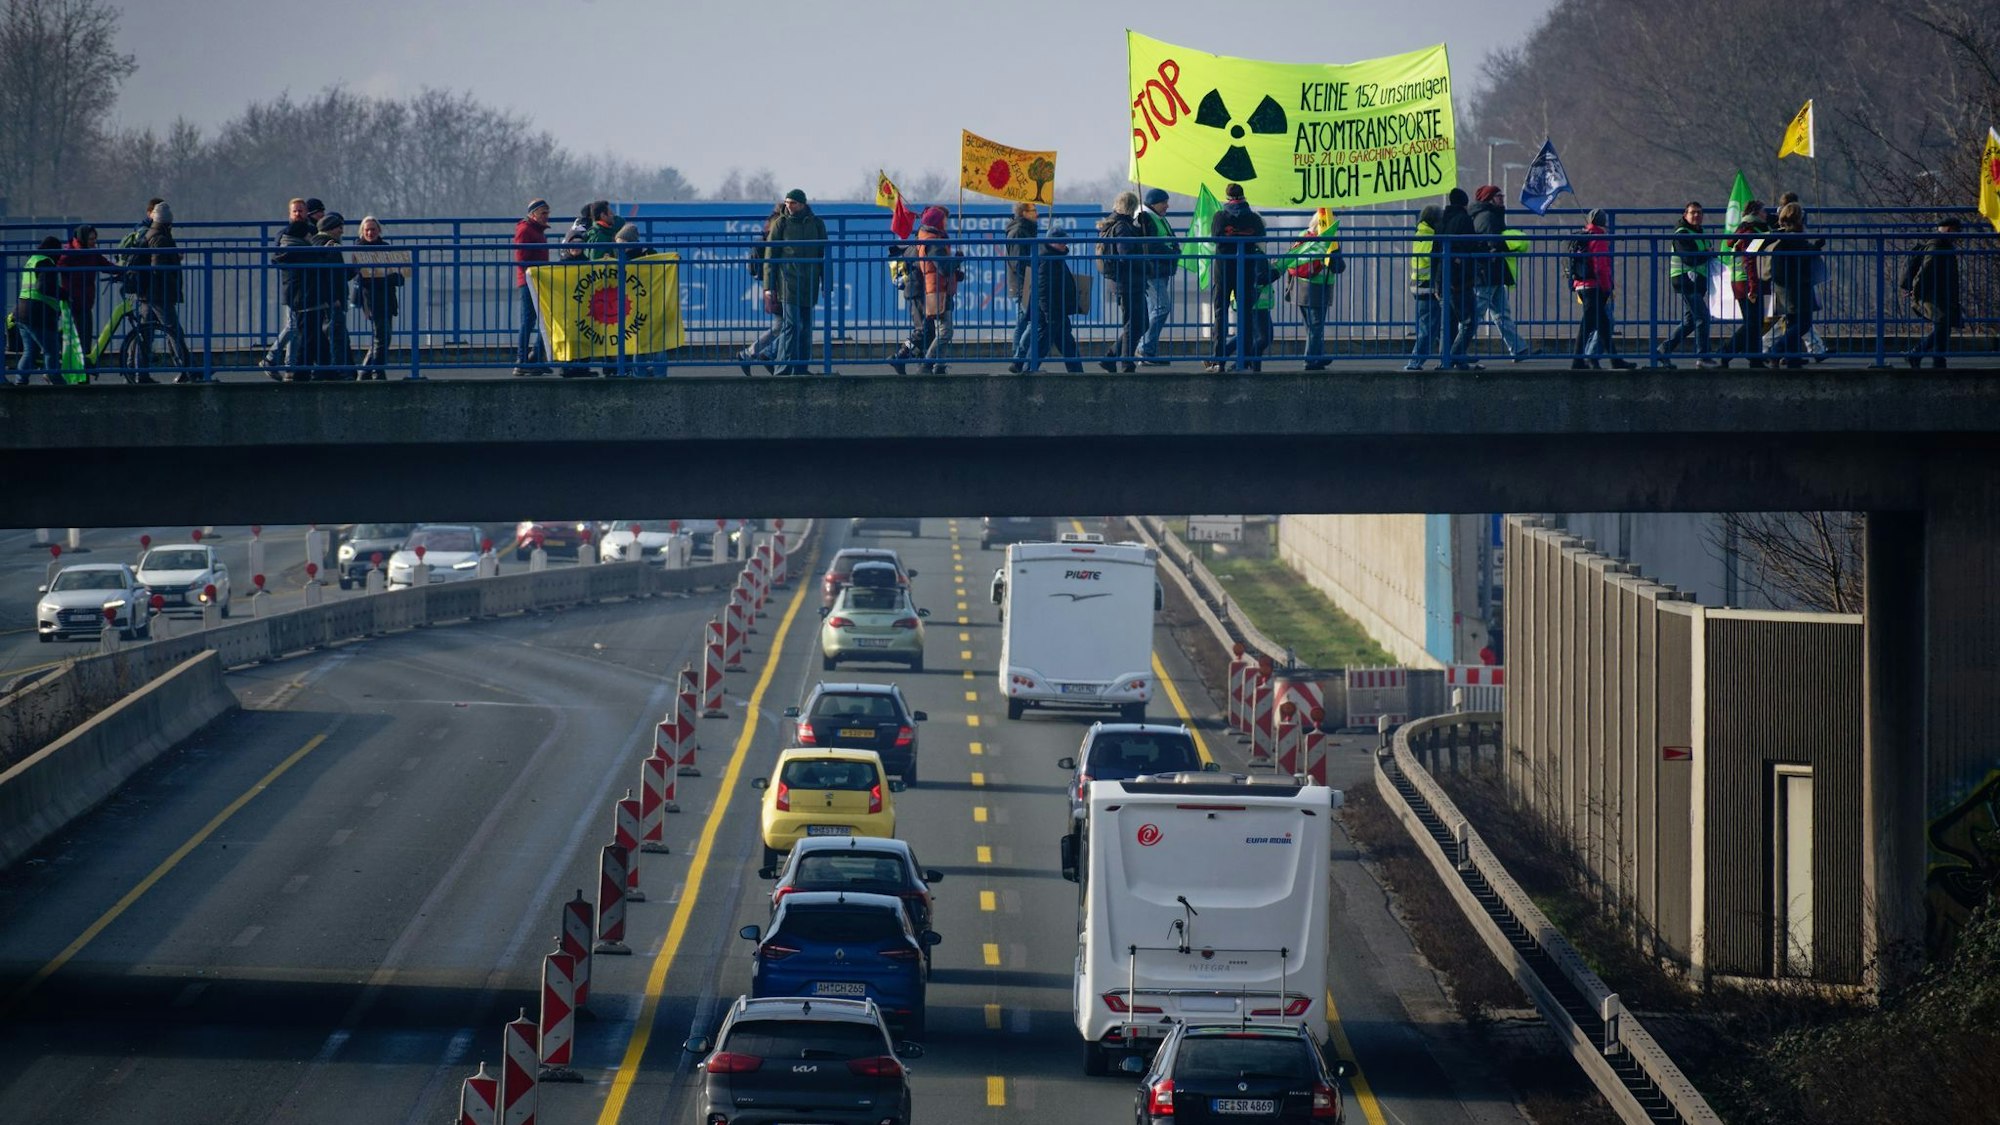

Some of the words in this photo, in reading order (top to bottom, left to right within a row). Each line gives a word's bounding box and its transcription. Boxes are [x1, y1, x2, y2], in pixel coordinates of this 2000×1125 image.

[1300, 82, 1350, 112] KEINE
[1355, 83, 1379, 108] 152
[1380, 76, 1448, 105] unsinnigen
[1132, 59, 1191, 158] STOP
[1294, 108, 1443, 153] ATOMTRANSPORTE
[1294, 153, 1315, 166] PLUS
[573, 268, 647, 303] ATOMKRFT?
[577, 318, 605, 346] NEIN
[610, 311, 648, 347] DNKE
[1064, 570, 1102, 580] PILOTE
[1188, 963, 1230, 972] INTEGRA
[818, 984, 829, 992] AH
[834, 984, 846, 993] CH
[792, 1065, 818, 1073] KIA
[1218, 1100, 1230, 1110] GE
[1237, 1101, 1248, 1111] SR
[1250, 1101, 1273, 1111] 4869
